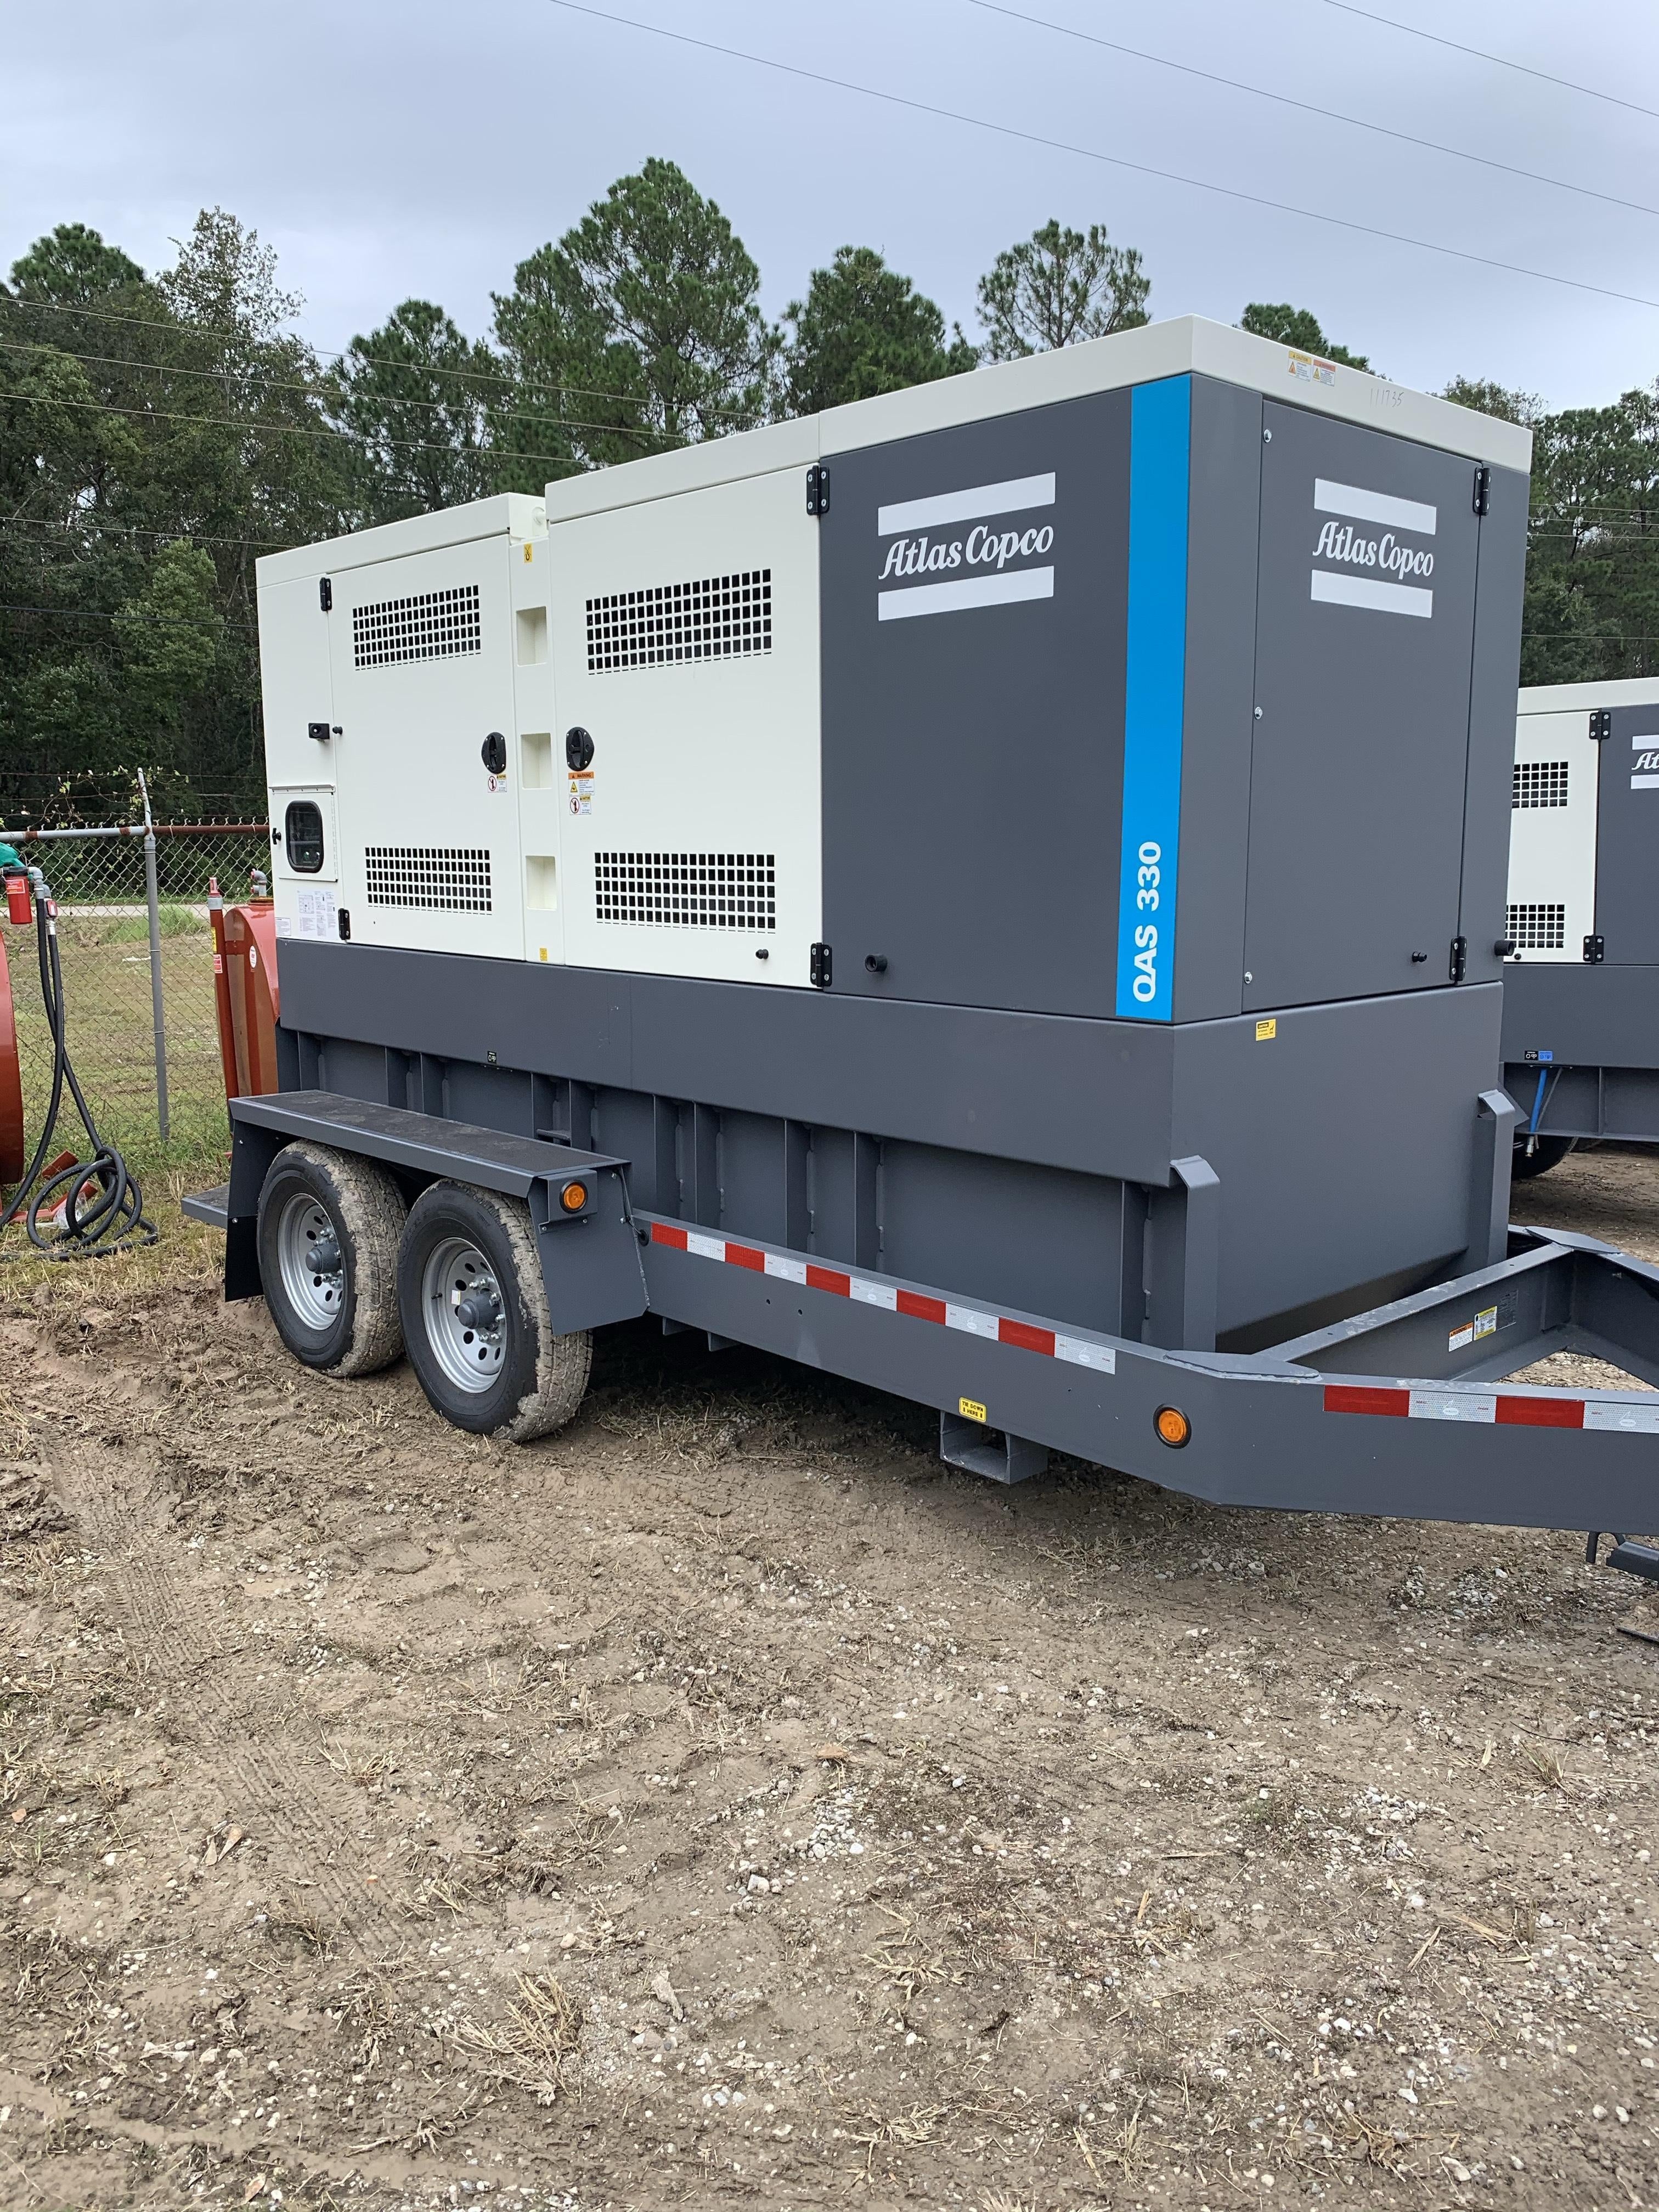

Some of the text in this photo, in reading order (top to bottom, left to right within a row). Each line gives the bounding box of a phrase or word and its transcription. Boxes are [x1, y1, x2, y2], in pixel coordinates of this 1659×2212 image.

[878, 526, 1054, 579] Atlas Copco
[1313, 522, 1434, 579] Atlas Copco
[1133, 841, 1161, 1002] QAS 330
[967, 1408, 978, 1417] HERE
[970, 1403, 984, 1412] DOWN
